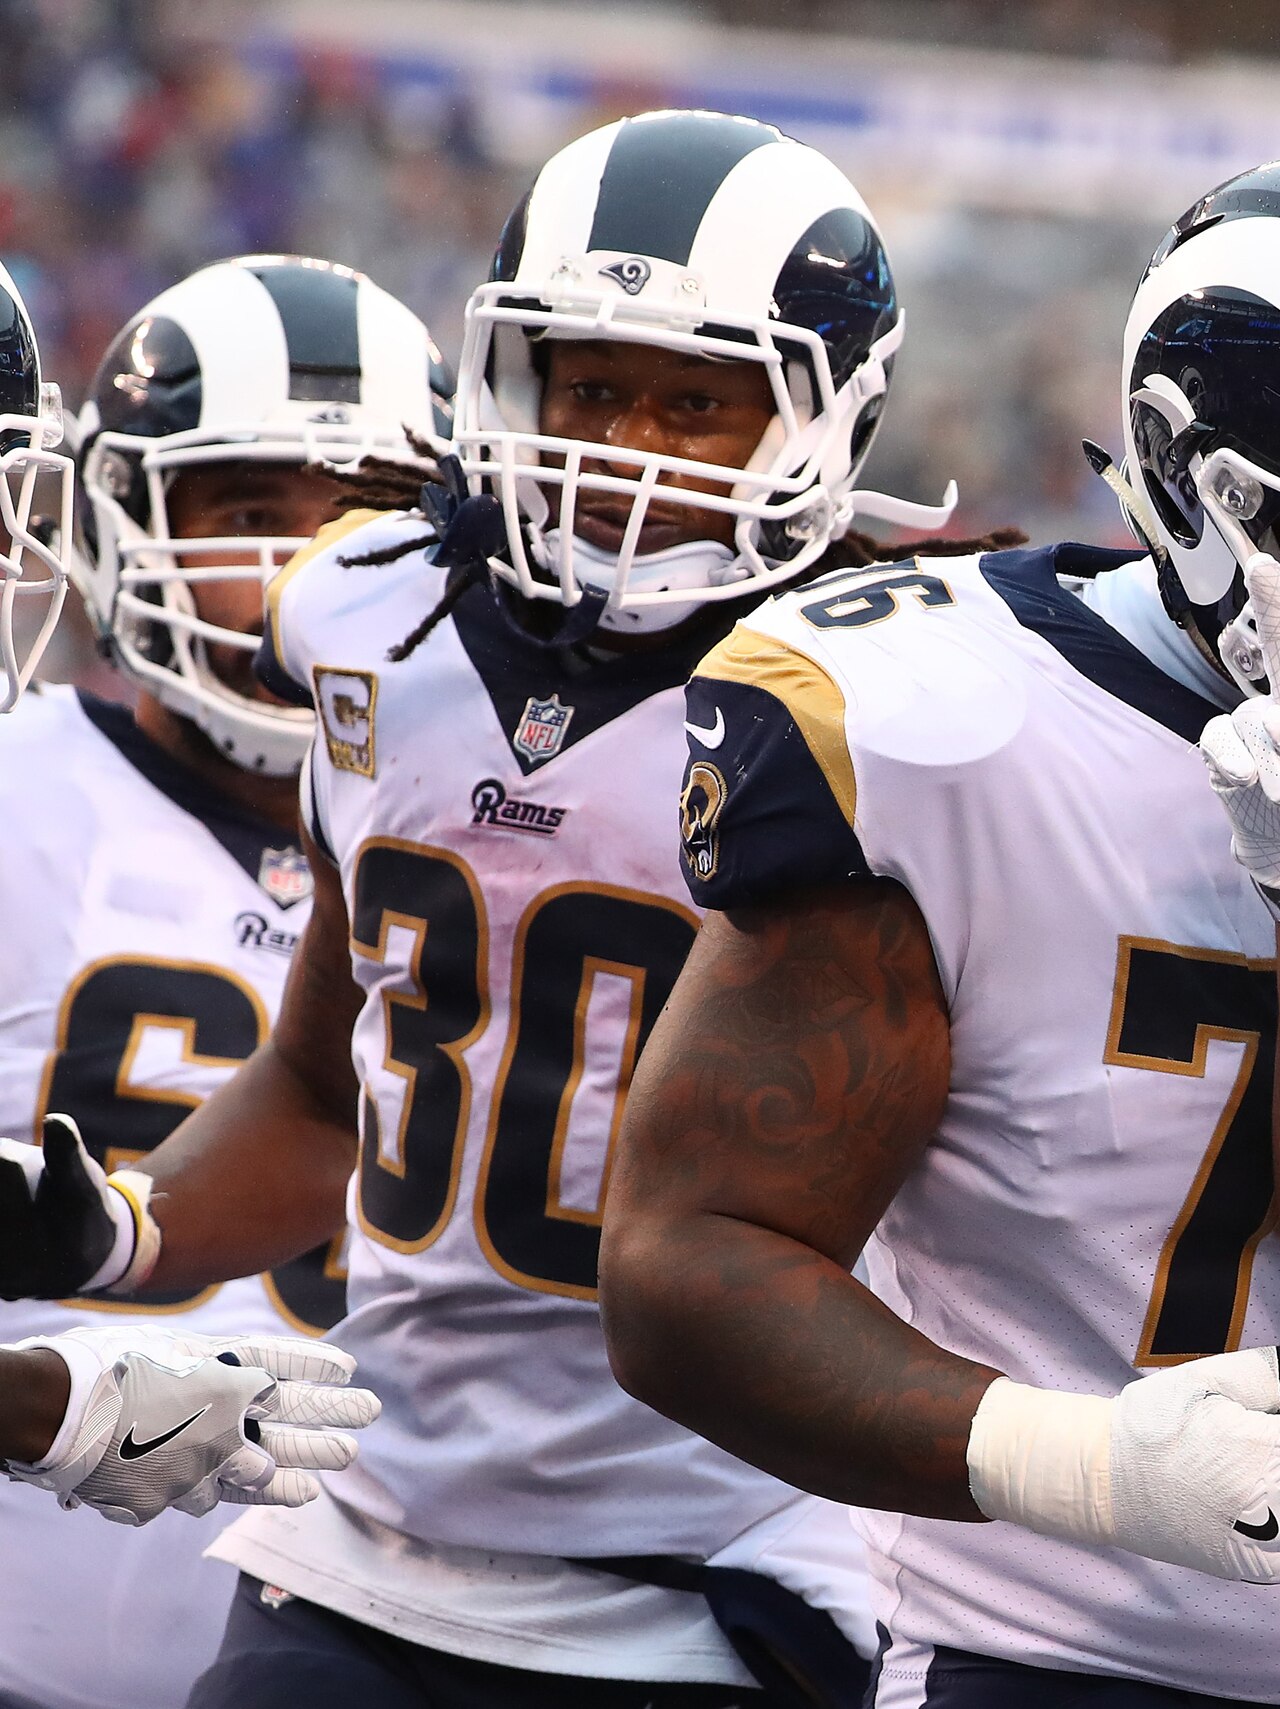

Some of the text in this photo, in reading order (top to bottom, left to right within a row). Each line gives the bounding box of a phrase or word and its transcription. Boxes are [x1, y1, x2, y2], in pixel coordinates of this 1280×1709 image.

[320, 672, 370, 746] C
[522, 723, 556, 751] NFL
[472, 779, 567, 833] Rams
[349, 836, 703, 1297] 30
